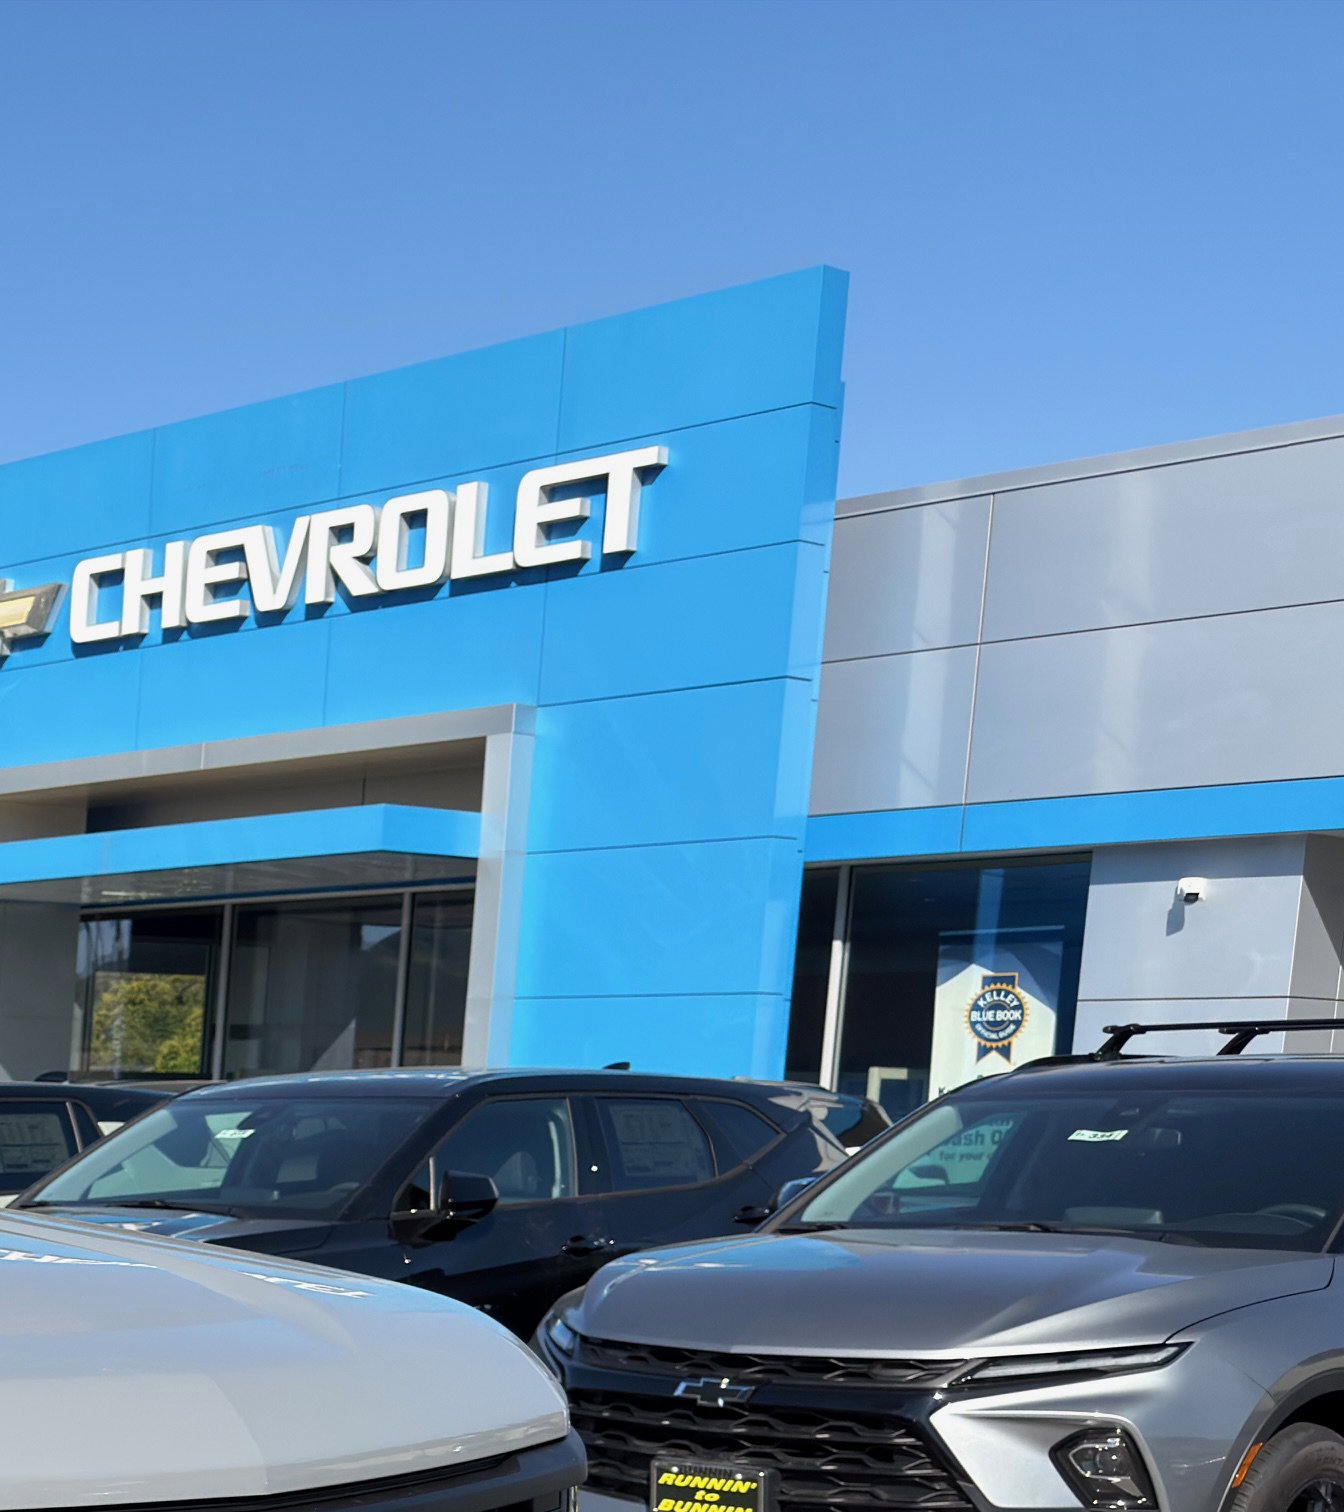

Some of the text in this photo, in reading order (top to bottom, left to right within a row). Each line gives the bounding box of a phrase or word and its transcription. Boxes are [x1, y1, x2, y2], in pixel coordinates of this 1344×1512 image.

[69, 445, 669, 645] CHEVROLET
[976, 990, 1020, 1007] KELLEY
[970, 1009, 1023, 1022] BLUE BOOK
[658, 1472, 758, 1494] RUNNIN'
[694, 1490, 721, 1502] to
